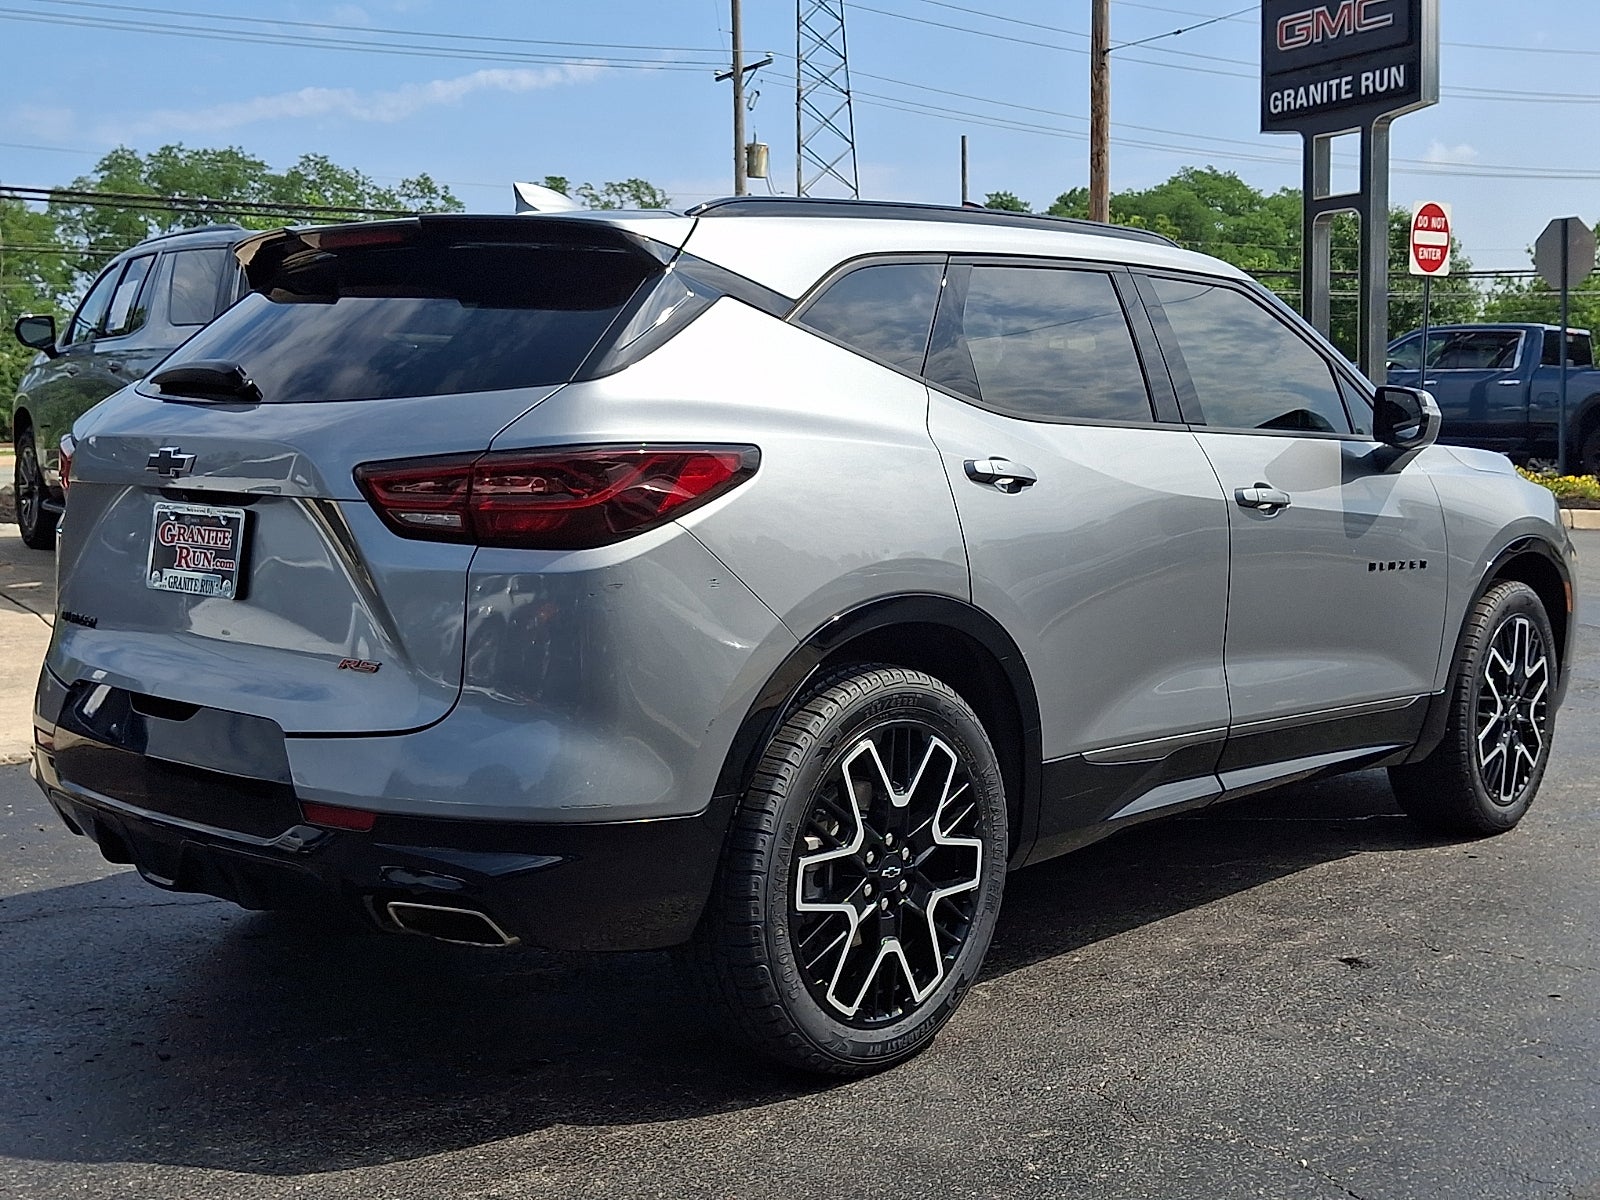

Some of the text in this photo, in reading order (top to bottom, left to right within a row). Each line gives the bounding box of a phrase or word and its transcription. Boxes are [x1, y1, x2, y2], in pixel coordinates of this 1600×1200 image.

[1277, 0, 1394, 51] GMC
[1269, 64, 1405, 115] GRANITE RUN
[1417, 215, 1446, 230] DO NOT
[1418, 247, 1442, 261] ENTER
[158, 520, 232, 549] GRANITE
[1368, 559, 1428, 572] BLAZER
[167, 575, 216, 594] GRANITE RUN
[337, 657, 382, 673] RS
